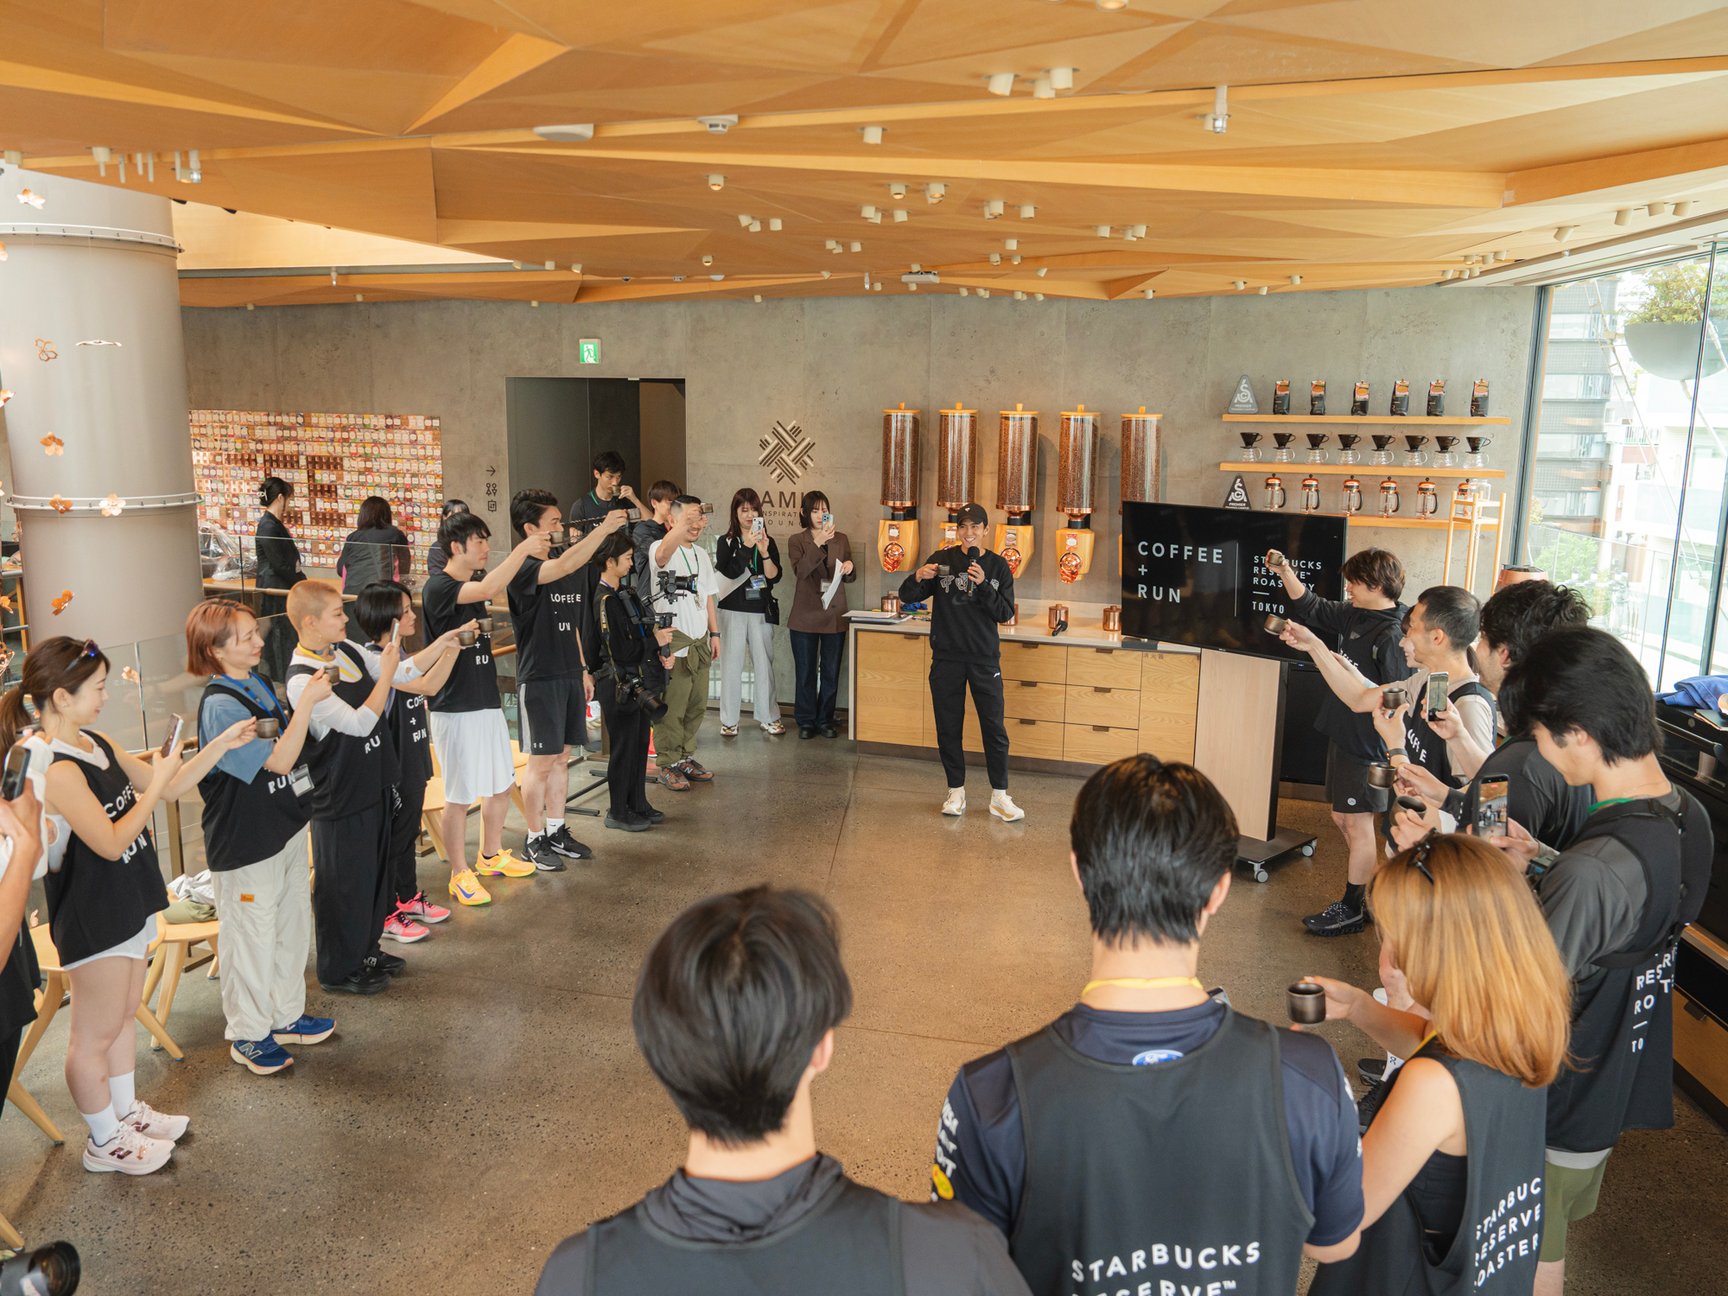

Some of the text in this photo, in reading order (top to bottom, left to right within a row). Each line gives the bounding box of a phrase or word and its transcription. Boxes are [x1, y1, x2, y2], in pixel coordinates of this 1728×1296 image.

[1138, 541, 1223, 564] COFFEE
[1254, 555, 1322, 570] STUCKS
[1253, 577, 1314, 591] ROASY
[1138, 584, 1181, 603] RUN
[1252, 601, 1285, 614] TOKYO
[1071, 1241, 1260, 1283] STARBUCKS
